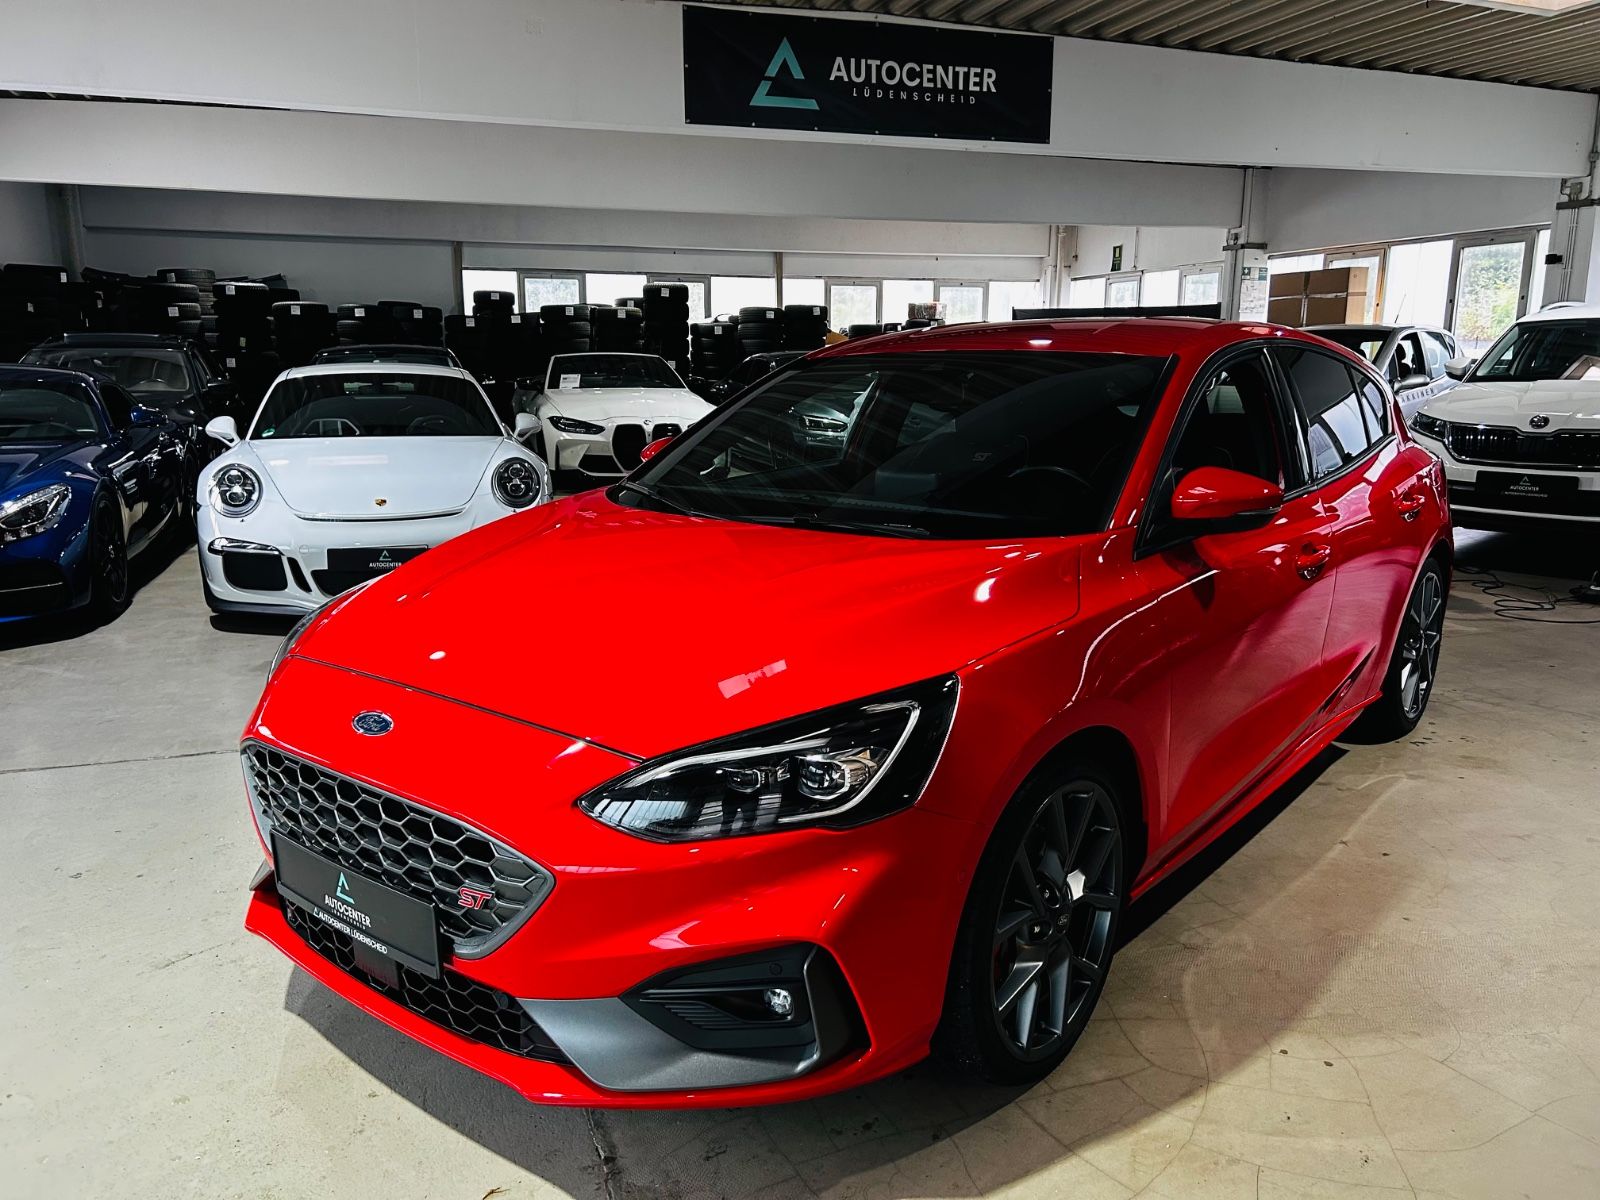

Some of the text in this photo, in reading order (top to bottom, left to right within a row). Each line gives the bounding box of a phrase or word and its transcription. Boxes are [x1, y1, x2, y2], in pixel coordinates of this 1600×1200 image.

[829, 56, 997, 93] AUTOCENTER
[853, 86, 976, 104] LÜDENSCHEID
[325, 894, 371, 928] AUTOCENTER
[458, 887, 492, 910] ST
[319, 911, 350, 936] AUTOCENTER
